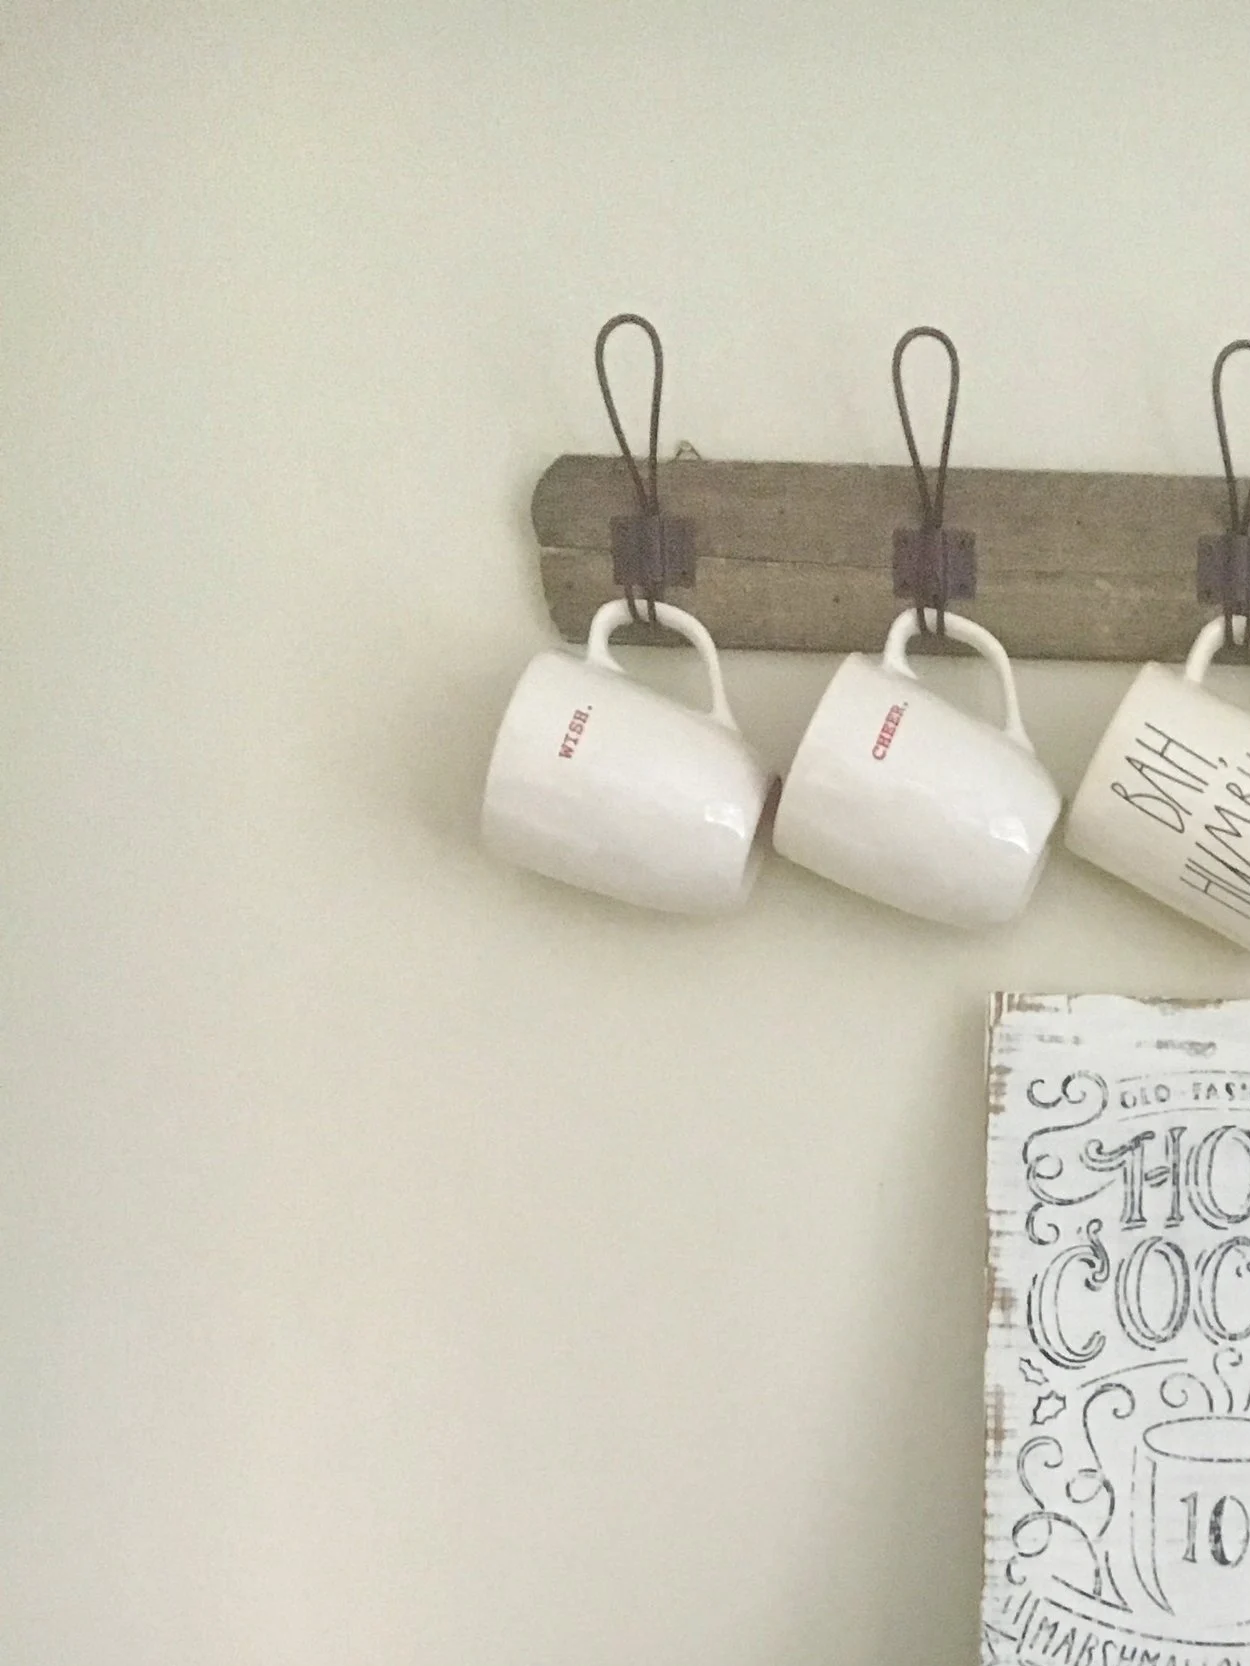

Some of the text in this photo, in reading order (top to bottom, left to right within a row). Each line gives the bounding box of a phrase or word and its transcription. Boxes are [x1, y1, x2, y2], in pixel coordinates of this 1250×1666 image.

[558, 704, 593, 760] WISH.
[871, 700, 909, 761] CHEER.
[1111, 721, 1228, 834] BAH,
[1119, 1083, 1171, 1110] OLD
